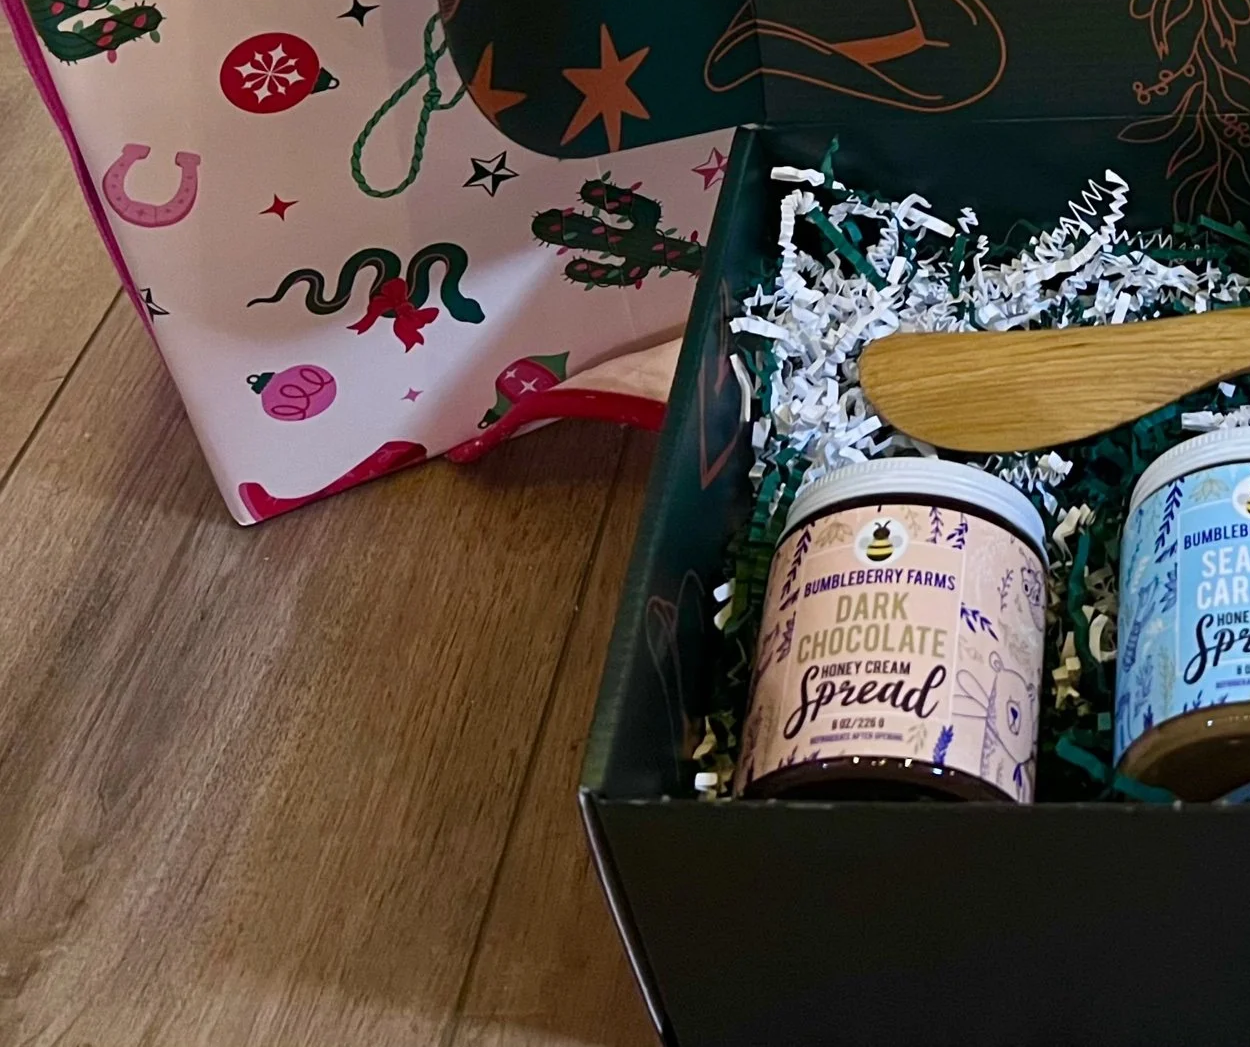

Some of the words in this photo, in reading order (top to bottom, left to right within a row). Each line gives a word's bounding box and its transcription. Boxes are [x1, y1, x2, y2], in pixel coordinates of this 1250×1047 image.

[804, 569, 902, 598] BUMBLEBERRY
[907, 569, 956, 591] FARMS
[836, 592, 910, 623] DARK
[798, 624, 948, 663] CHOCOLATE
[821, 661, 861, 678] HONEY
[865, 660, 911, 675] CREAM
[783, 664, 947, 739] Spread
